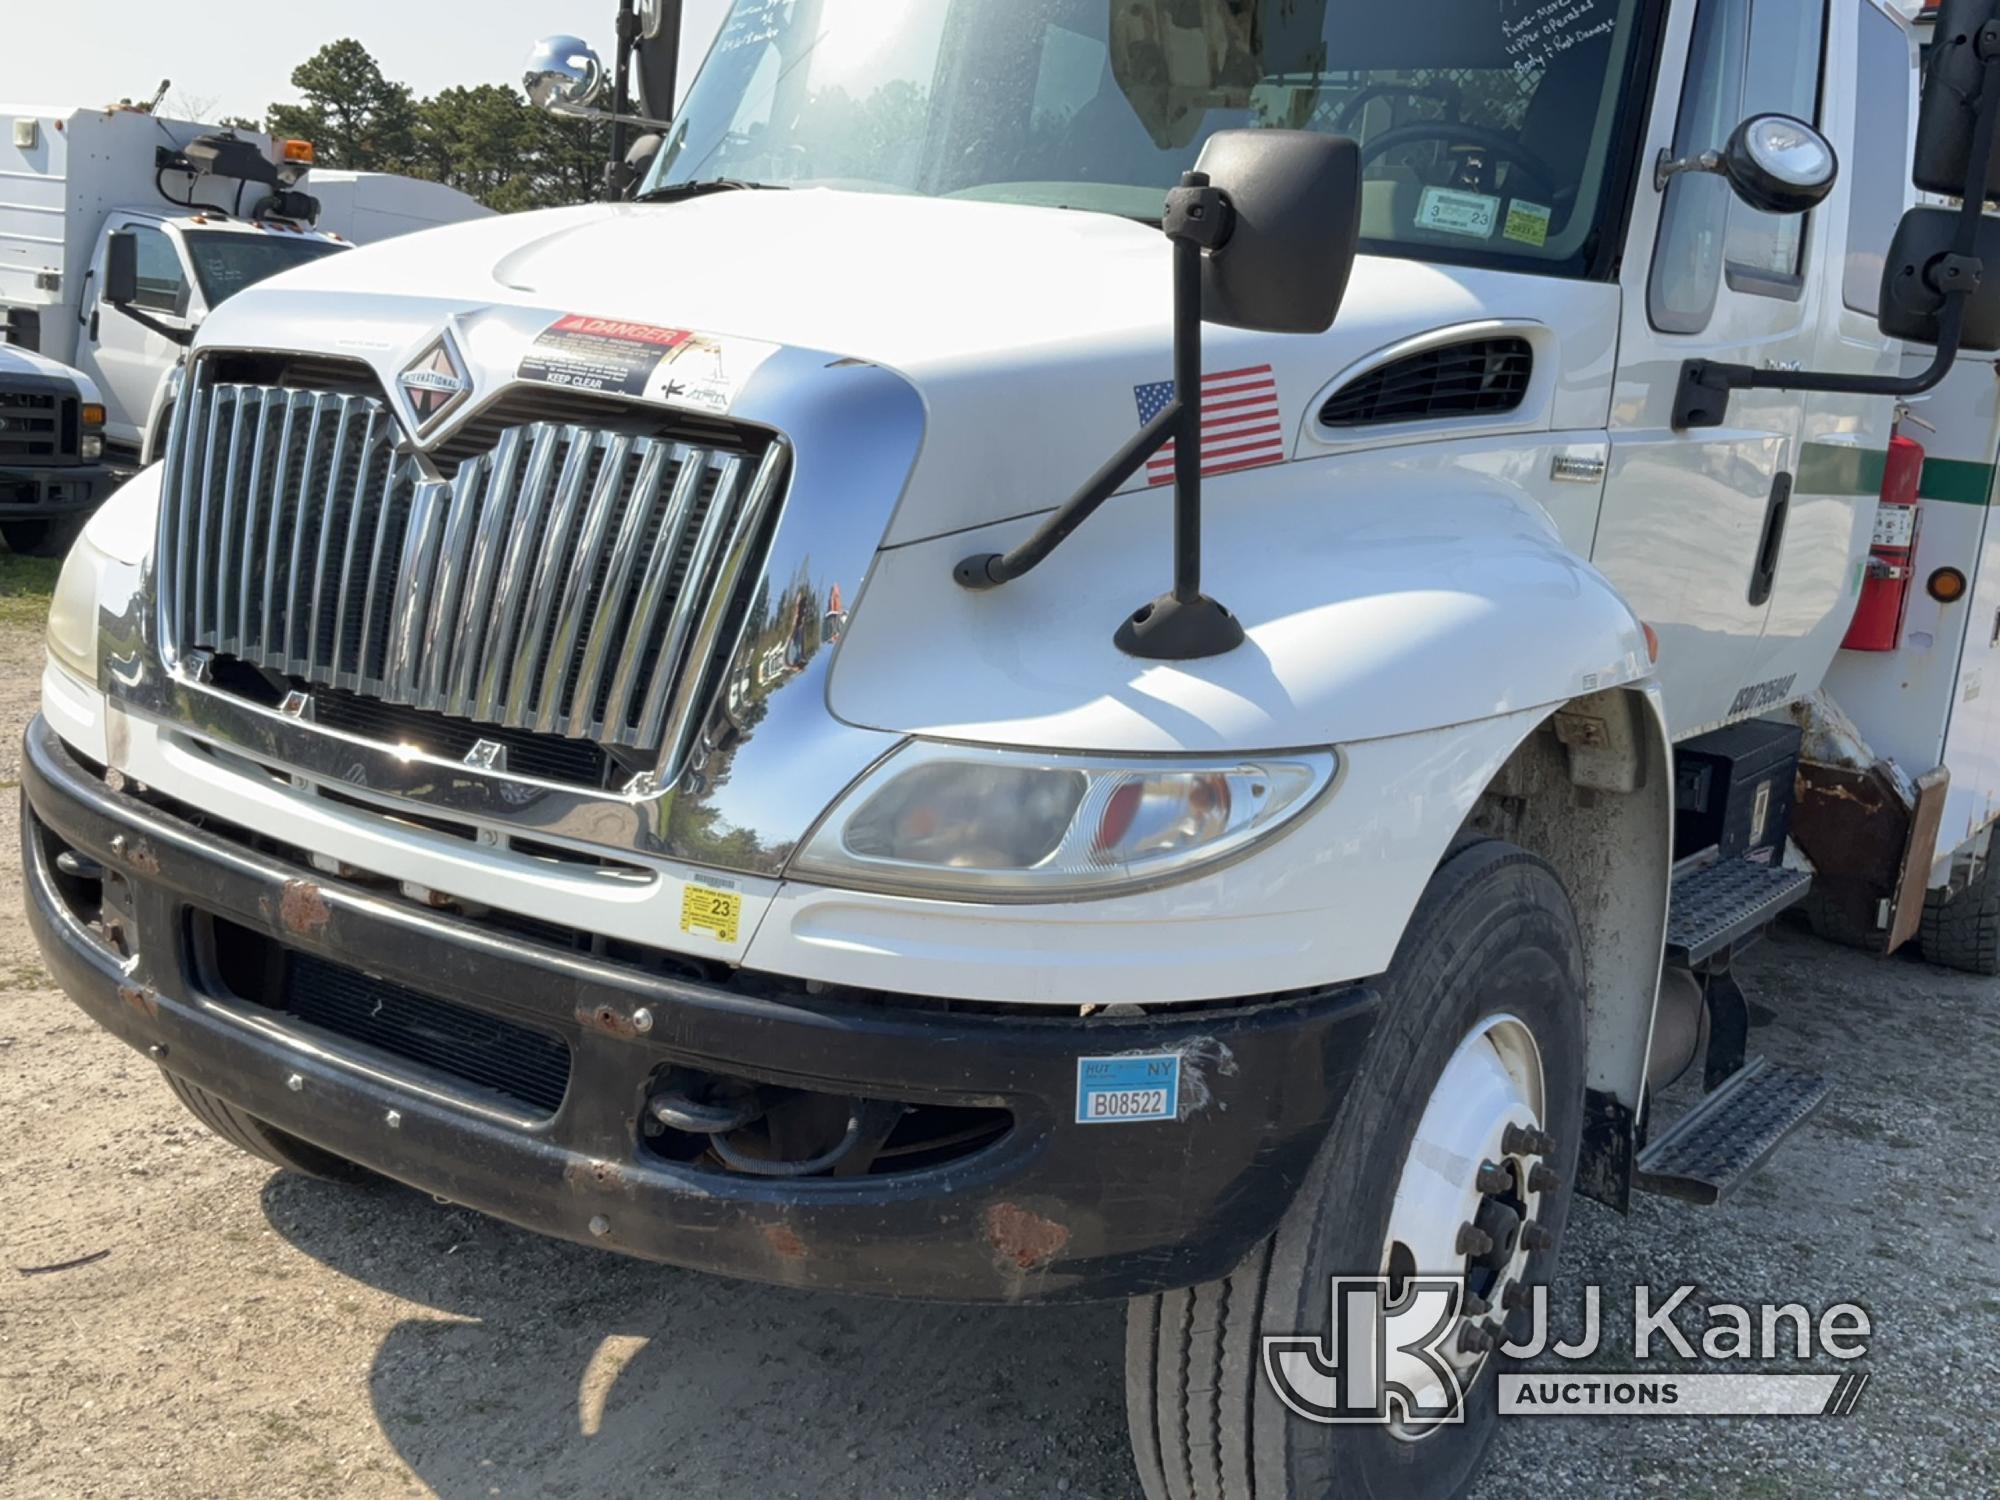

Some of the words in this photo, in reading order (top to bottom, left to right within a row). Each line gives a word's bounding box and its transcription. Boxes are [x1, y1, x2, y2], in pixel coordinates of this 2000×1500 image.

[1431, 205, 1440, 218] 3
[1471, 212, 1489, 226] 23
[585, 319, 678, 343] DANGER
[547, 372, 572, 384] KEEP
[572, 375, 603, 389] CLEAR
[711, 898, 730, 917] 23
[1148, 1062, 1173, 1077] NY
[1094, 1090, 1162, 1116] B08522
